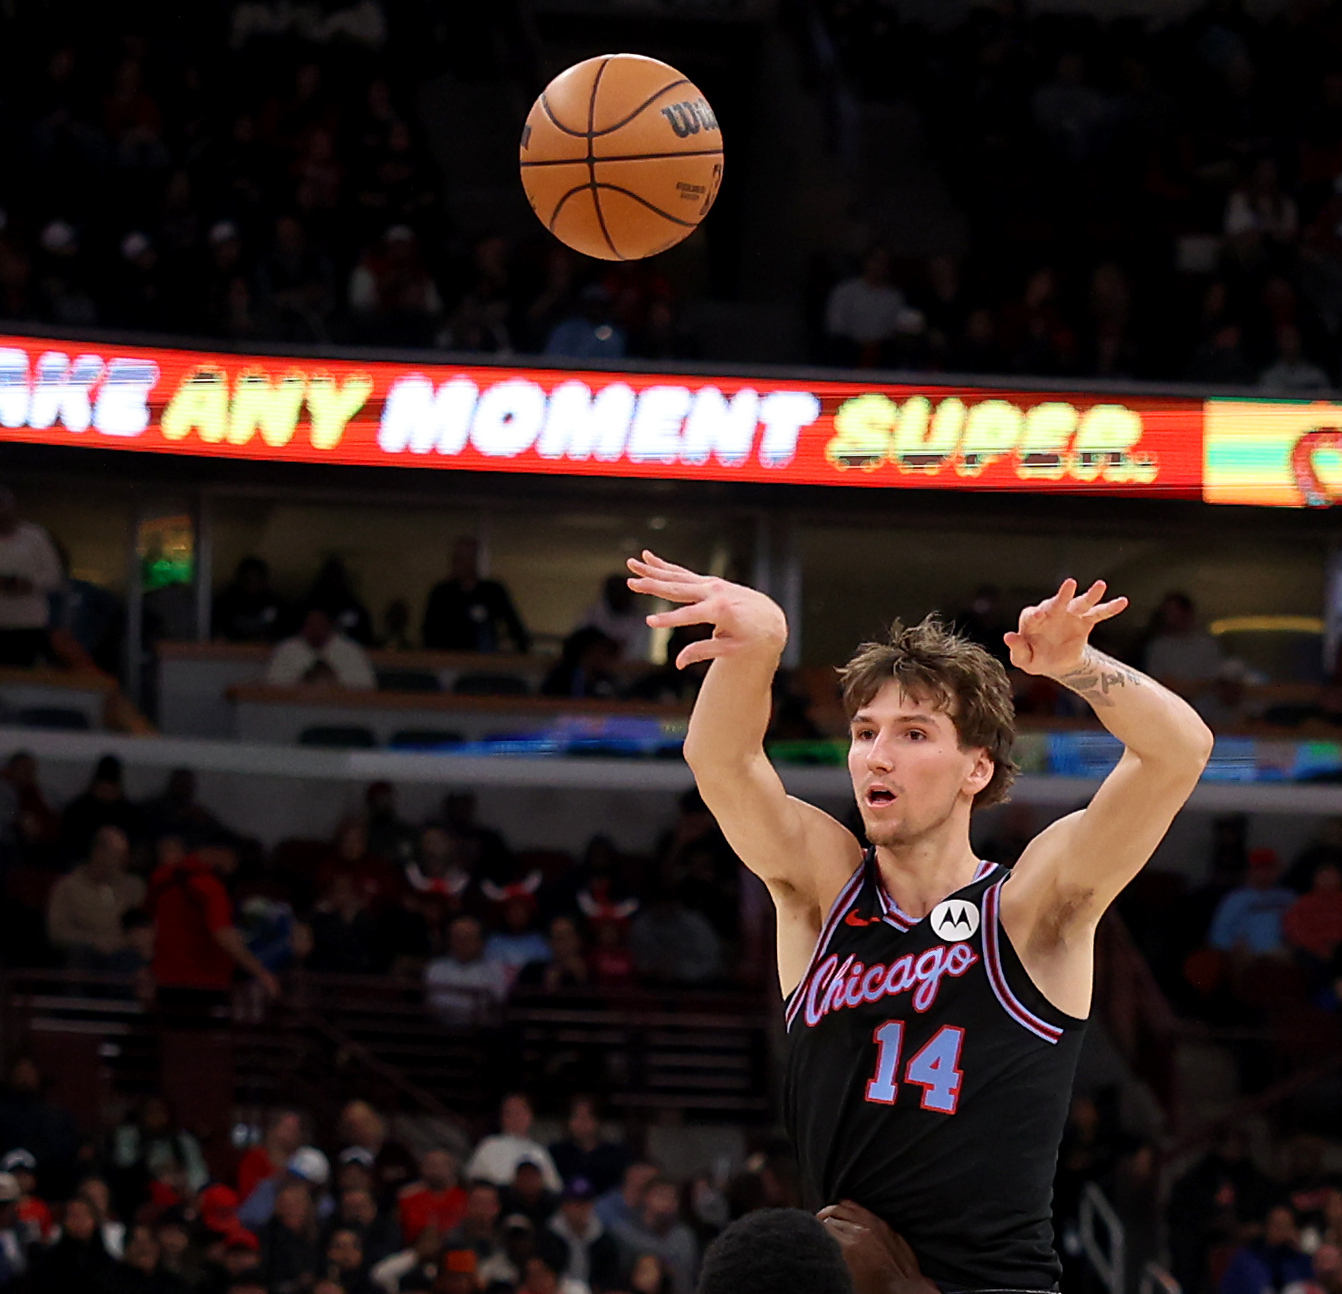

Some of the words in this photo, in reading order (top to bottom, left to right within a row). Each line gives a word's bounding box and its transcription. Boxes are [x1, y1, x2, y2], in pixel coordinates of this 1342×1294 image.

[160, 361, 373, 450] ANY
[378, 371, 821, 469] MOMENT
[804, 942, 979, 1027] Chicago
[865, 1019, 966, 1115] 14
